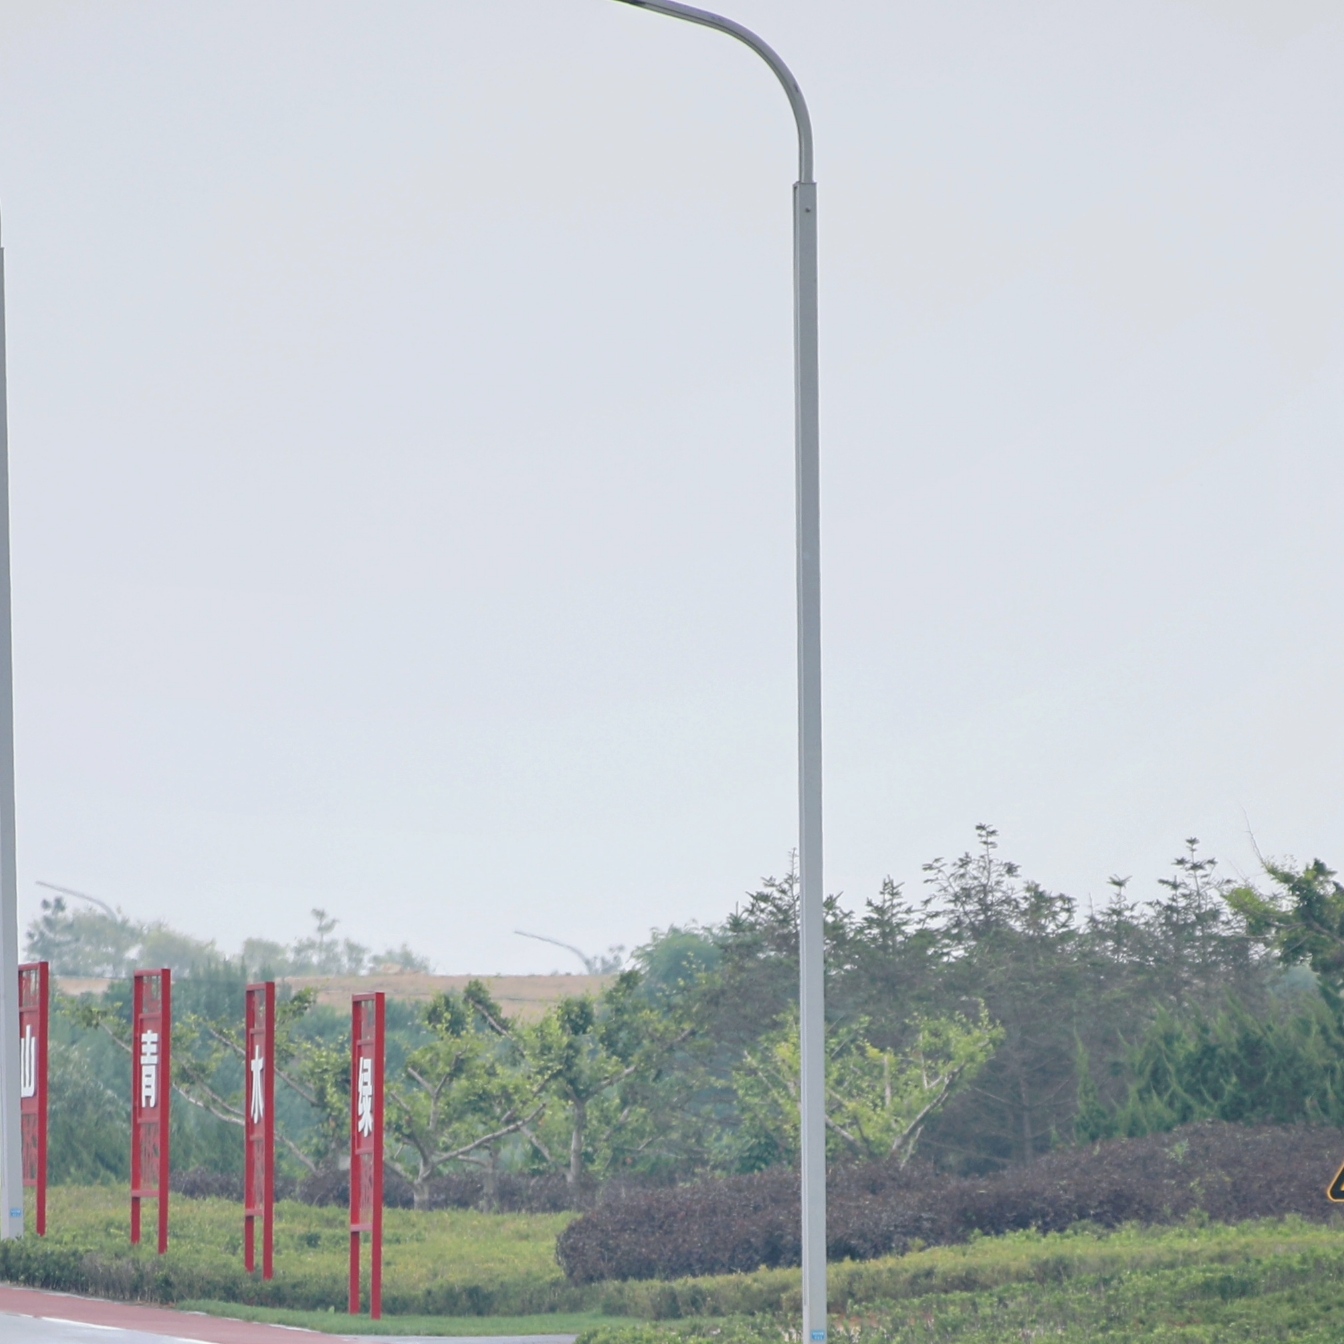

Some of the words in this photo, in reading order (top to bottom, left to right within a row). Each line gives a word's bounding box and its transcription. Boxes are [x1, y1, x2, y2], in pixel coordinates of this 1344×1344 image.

[20, 1024, 35, 1098] 山
[141, 1029, 158, 1108] 青
[358, 1056, 373, 1138] 绿
